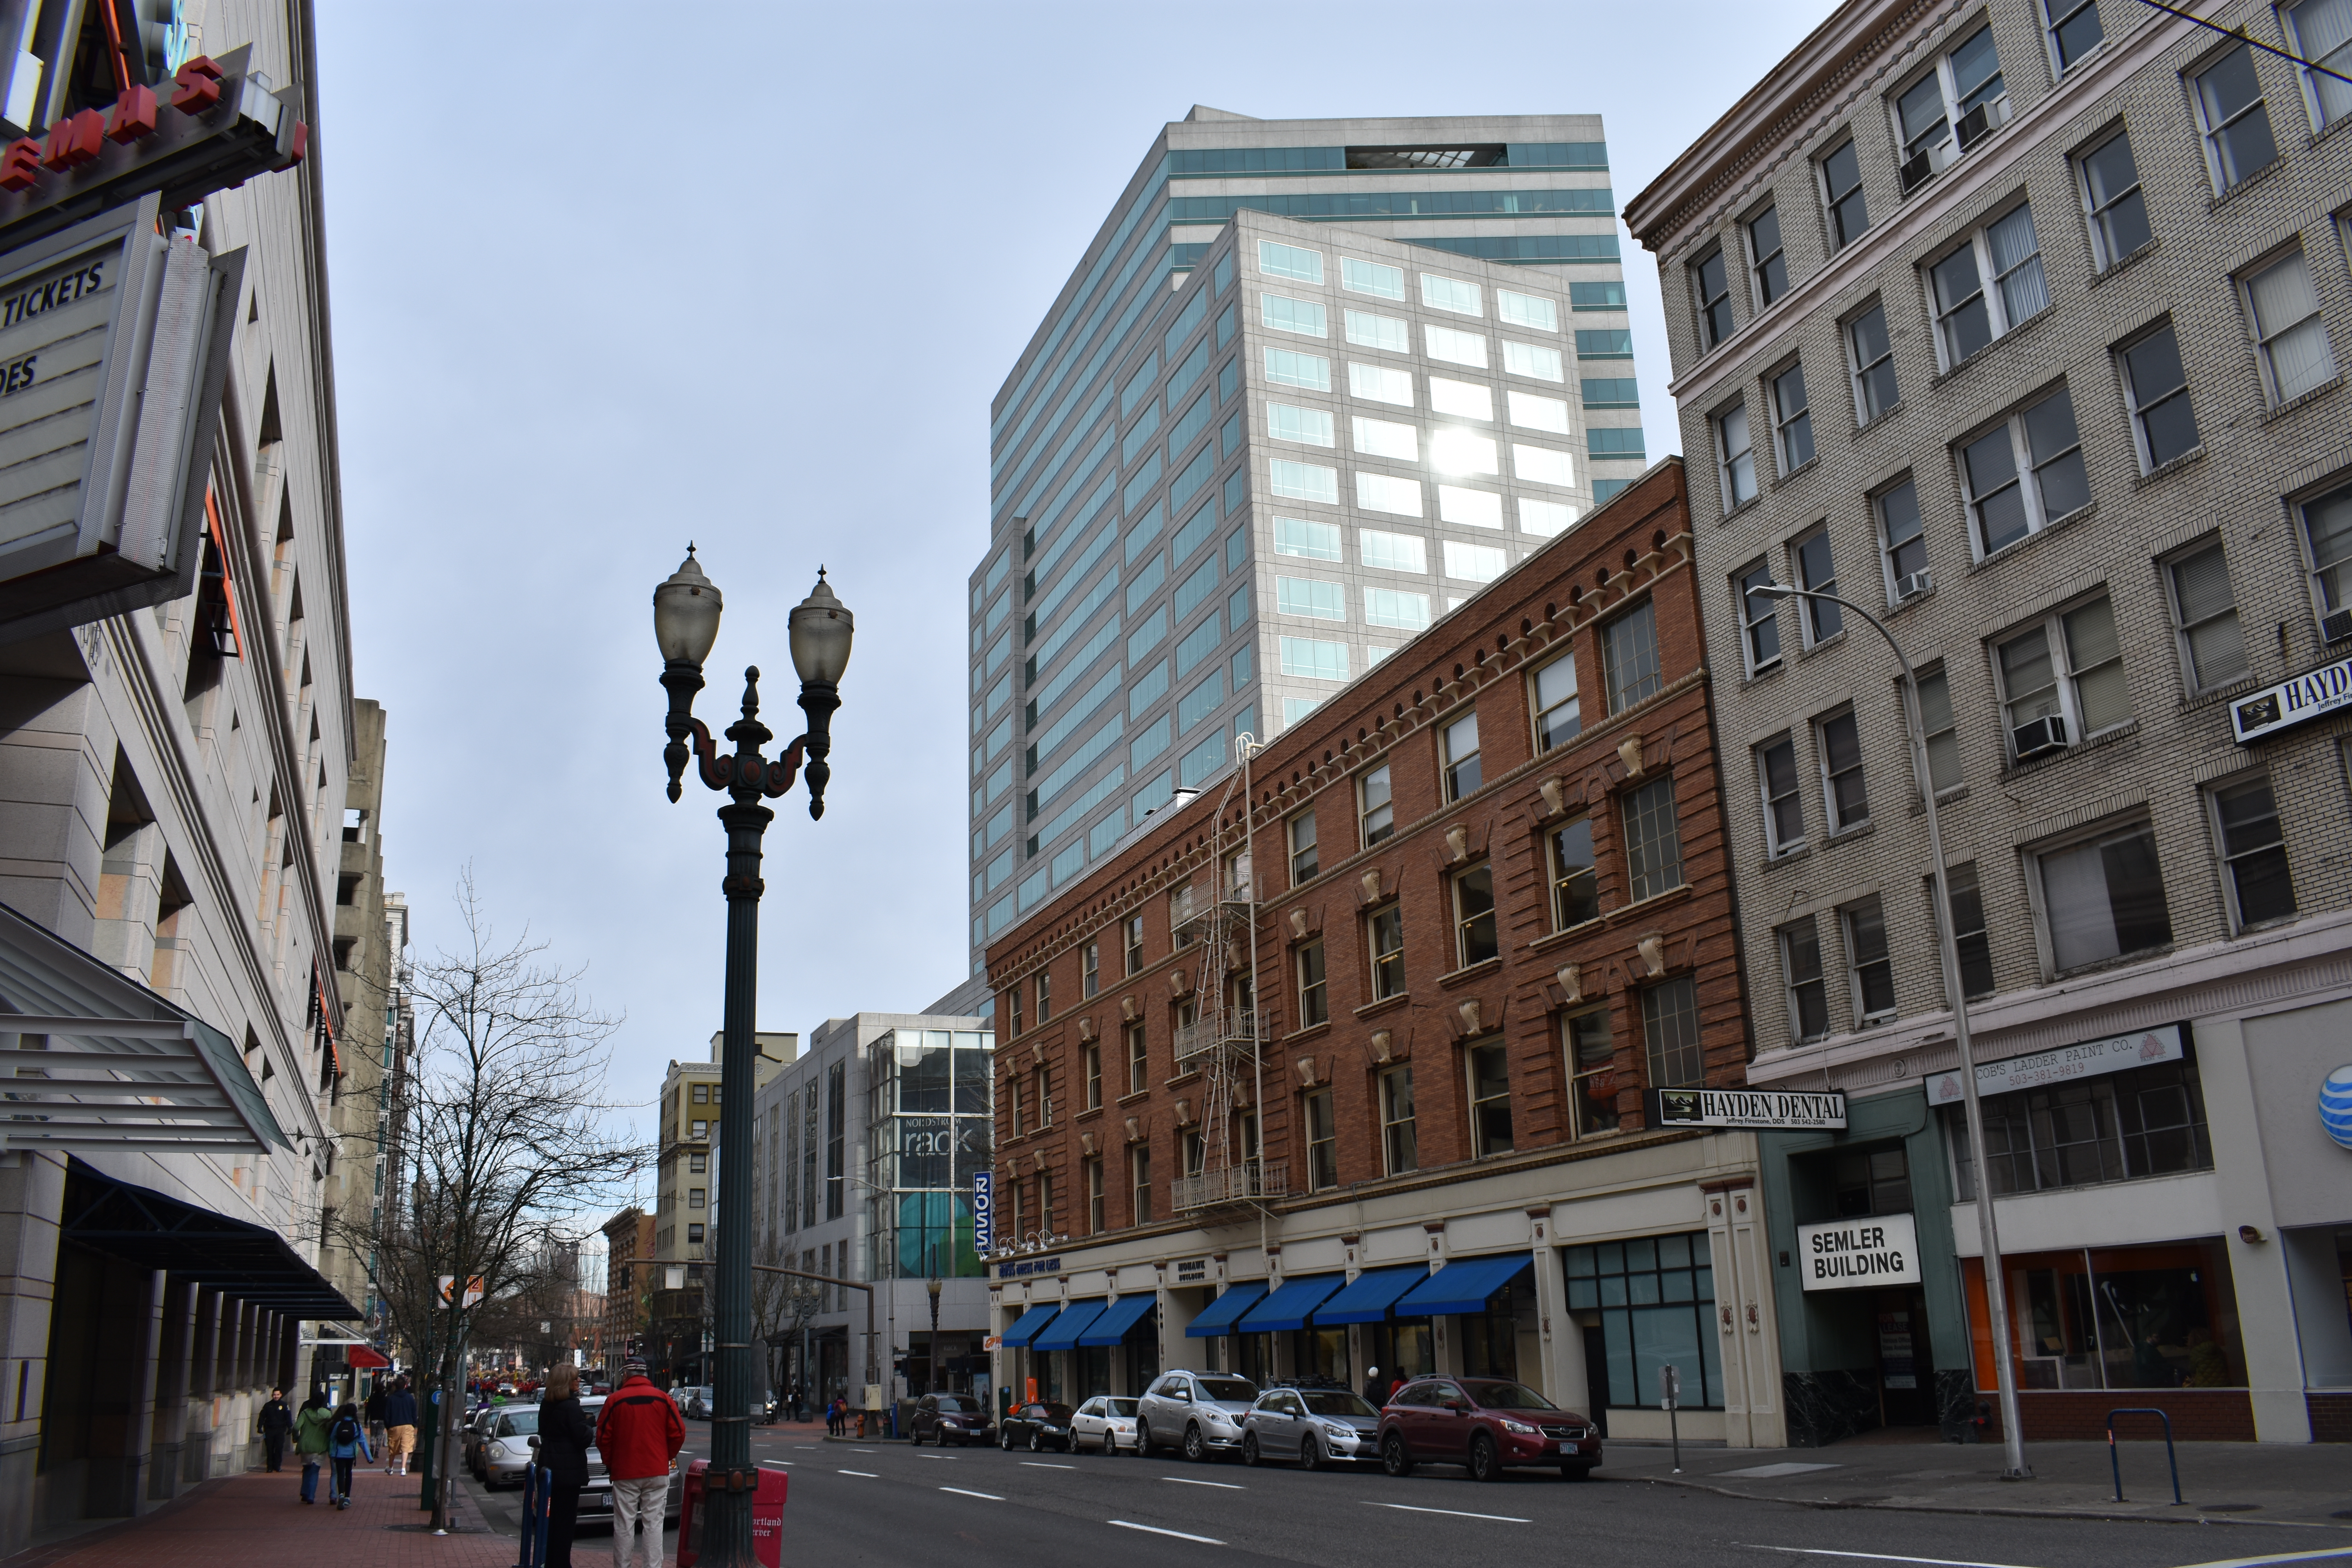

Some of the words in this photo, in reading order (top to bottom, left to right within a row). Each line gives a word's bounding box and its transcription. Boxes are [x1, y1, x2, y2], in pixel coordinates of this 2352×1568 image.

[4, 261, 103, 327] TICKETS
[2318, 697, 2341, 711] Jeffrey
[1976, 1065, 2005, 1080] COB'S
[2013, 1054, 2058, 1072] LADDER
[2066, 1044, 2103, 1062] PAINT
[2112, 1039, 2132, 1052] CO.
[2009, 1062, 2084, 1086] 503-381-9819
[1703, 1093, 1772, 1117] HAYDEN
[1777, 1096, 1844, 1119] DENTAL
[906, 1126, 972, 1157] rack
[975, 1178, 989, 1245] ROSS
[1812, 1227, 1885, 1253] SEMLER
[1178, 1260, 1205, 1271] MOHAWK
[1179, 1272, 1205, 1281] BUILDING
[1814, 1251, 1904, 1278] BUILDING
[472, 1278, 479, 1289] 2
[1878, 1314, 1892, 1322] FOR
[1883, 1323, 1908, 1332] LEASE
[753, 1517, 781, 1526] ortland
